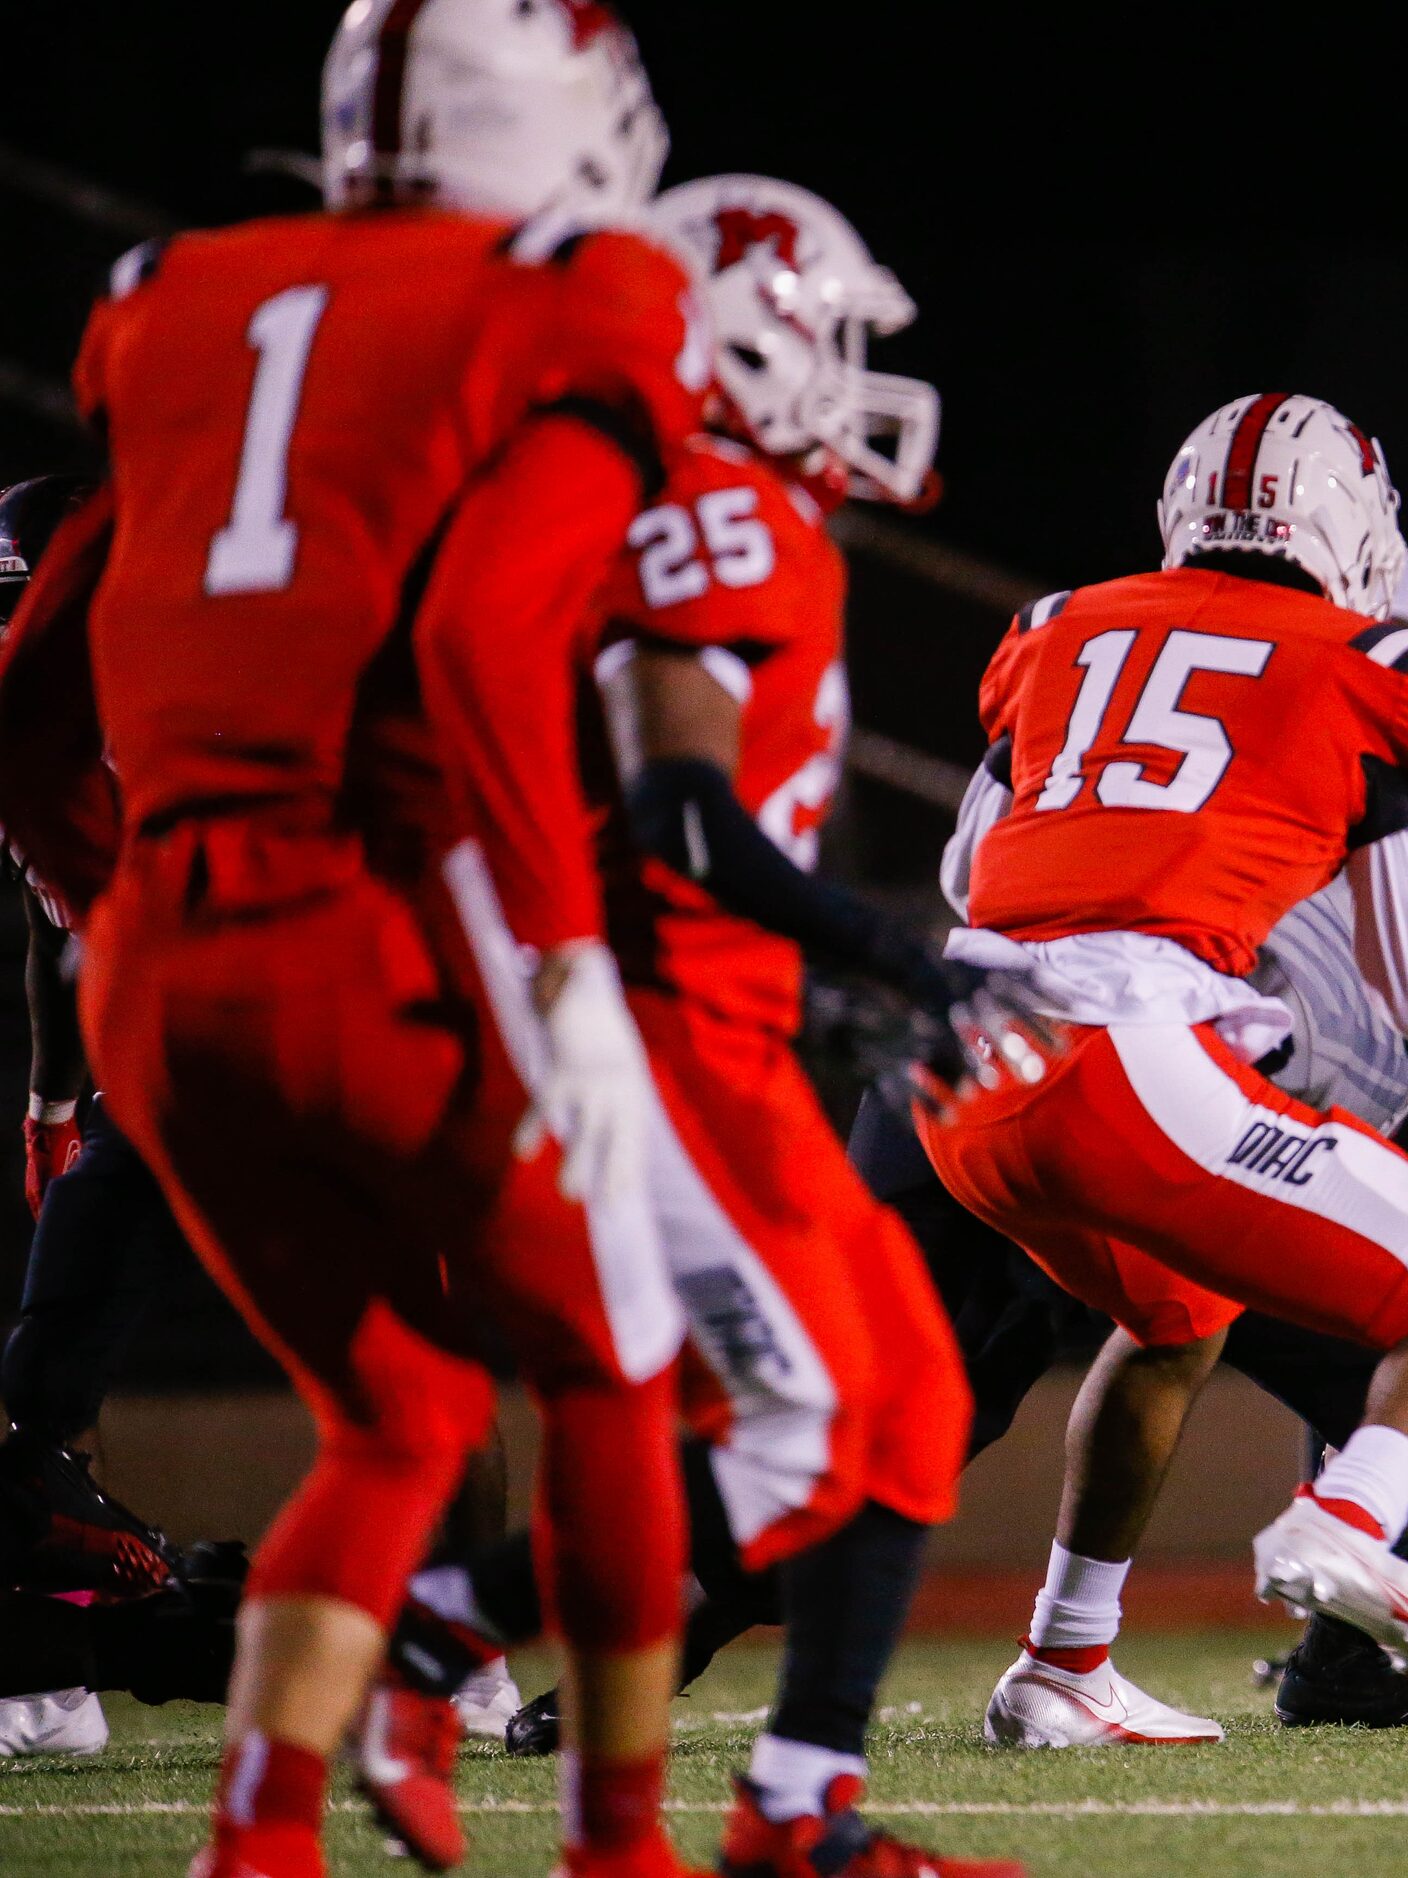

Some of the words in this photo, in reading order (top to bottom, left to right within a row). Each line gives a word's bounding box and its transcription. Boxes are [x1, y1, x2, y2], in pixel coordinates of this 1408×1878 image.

[204, 283, 332, 597] 1
[628, 485, 776, 610] 25
[1033, 628, 1278, 814] 15
